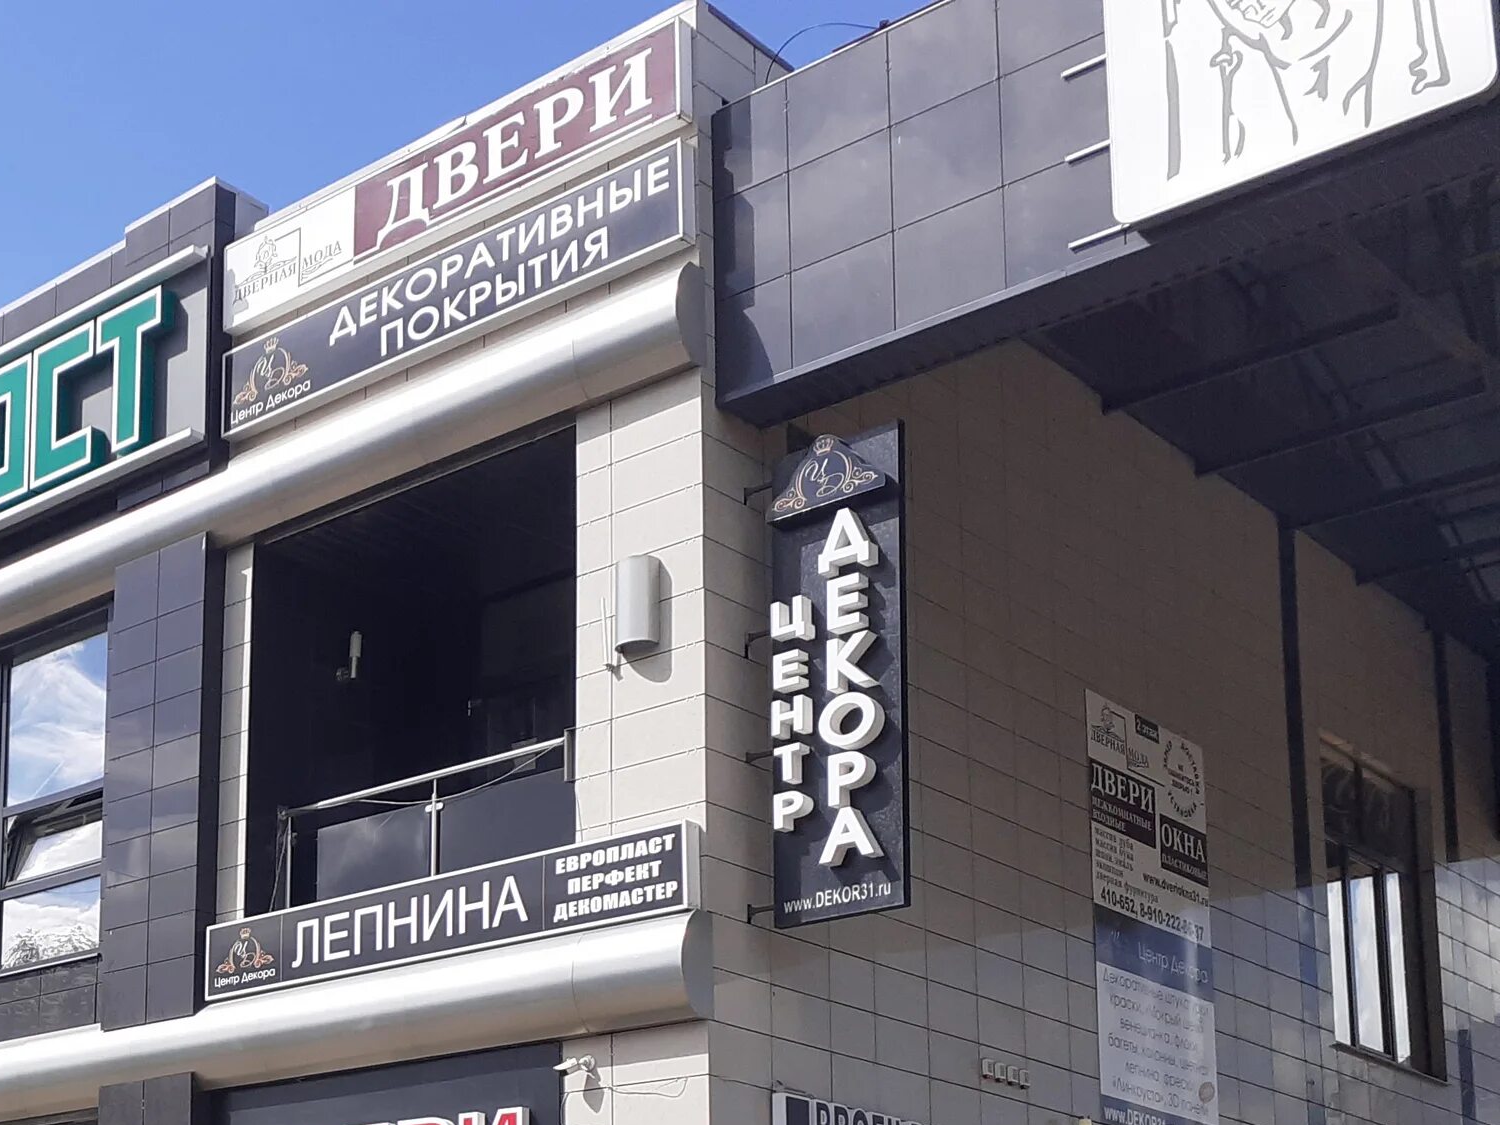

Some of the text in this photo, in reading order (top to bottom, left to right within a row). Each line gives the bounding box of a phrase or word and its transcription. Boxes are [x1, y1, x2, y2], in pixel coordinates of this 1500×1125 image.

[375, 47, 653, 253] ДВЕРИ
[233, 240, 342, 305] ДВЕРНАЯ МОДА
[329, 155, 671, 346] ДЕКОРАТИВНЫЕ
[378, 228, 609, 357] ПОКРЫТИЯ
[230, 380, 311, 425] Центр Декора
[818, 507, 886, 869] ДЕКОРА
[770, 594, 816, 834] ЦЕНТР
[1090, 762, 1155, 815] ДВЕРИ
[555, 832, 677, 876] ЕВРОПЛАСТ
[1160, 823, 1206, 863] ОКНА
[553, 880, 679, 924] ДЕКОМАСТЕР
[567, 859, 663, 896] ПЕРФЕКТ
[783, 881, 892, 914] www.DEKOR31.ru
[291, 875, 530, 968] ЛЕПНИНА
[214, 968, 276, 988] Центр Декора
[1138, 942, 1169, 969] Центр
